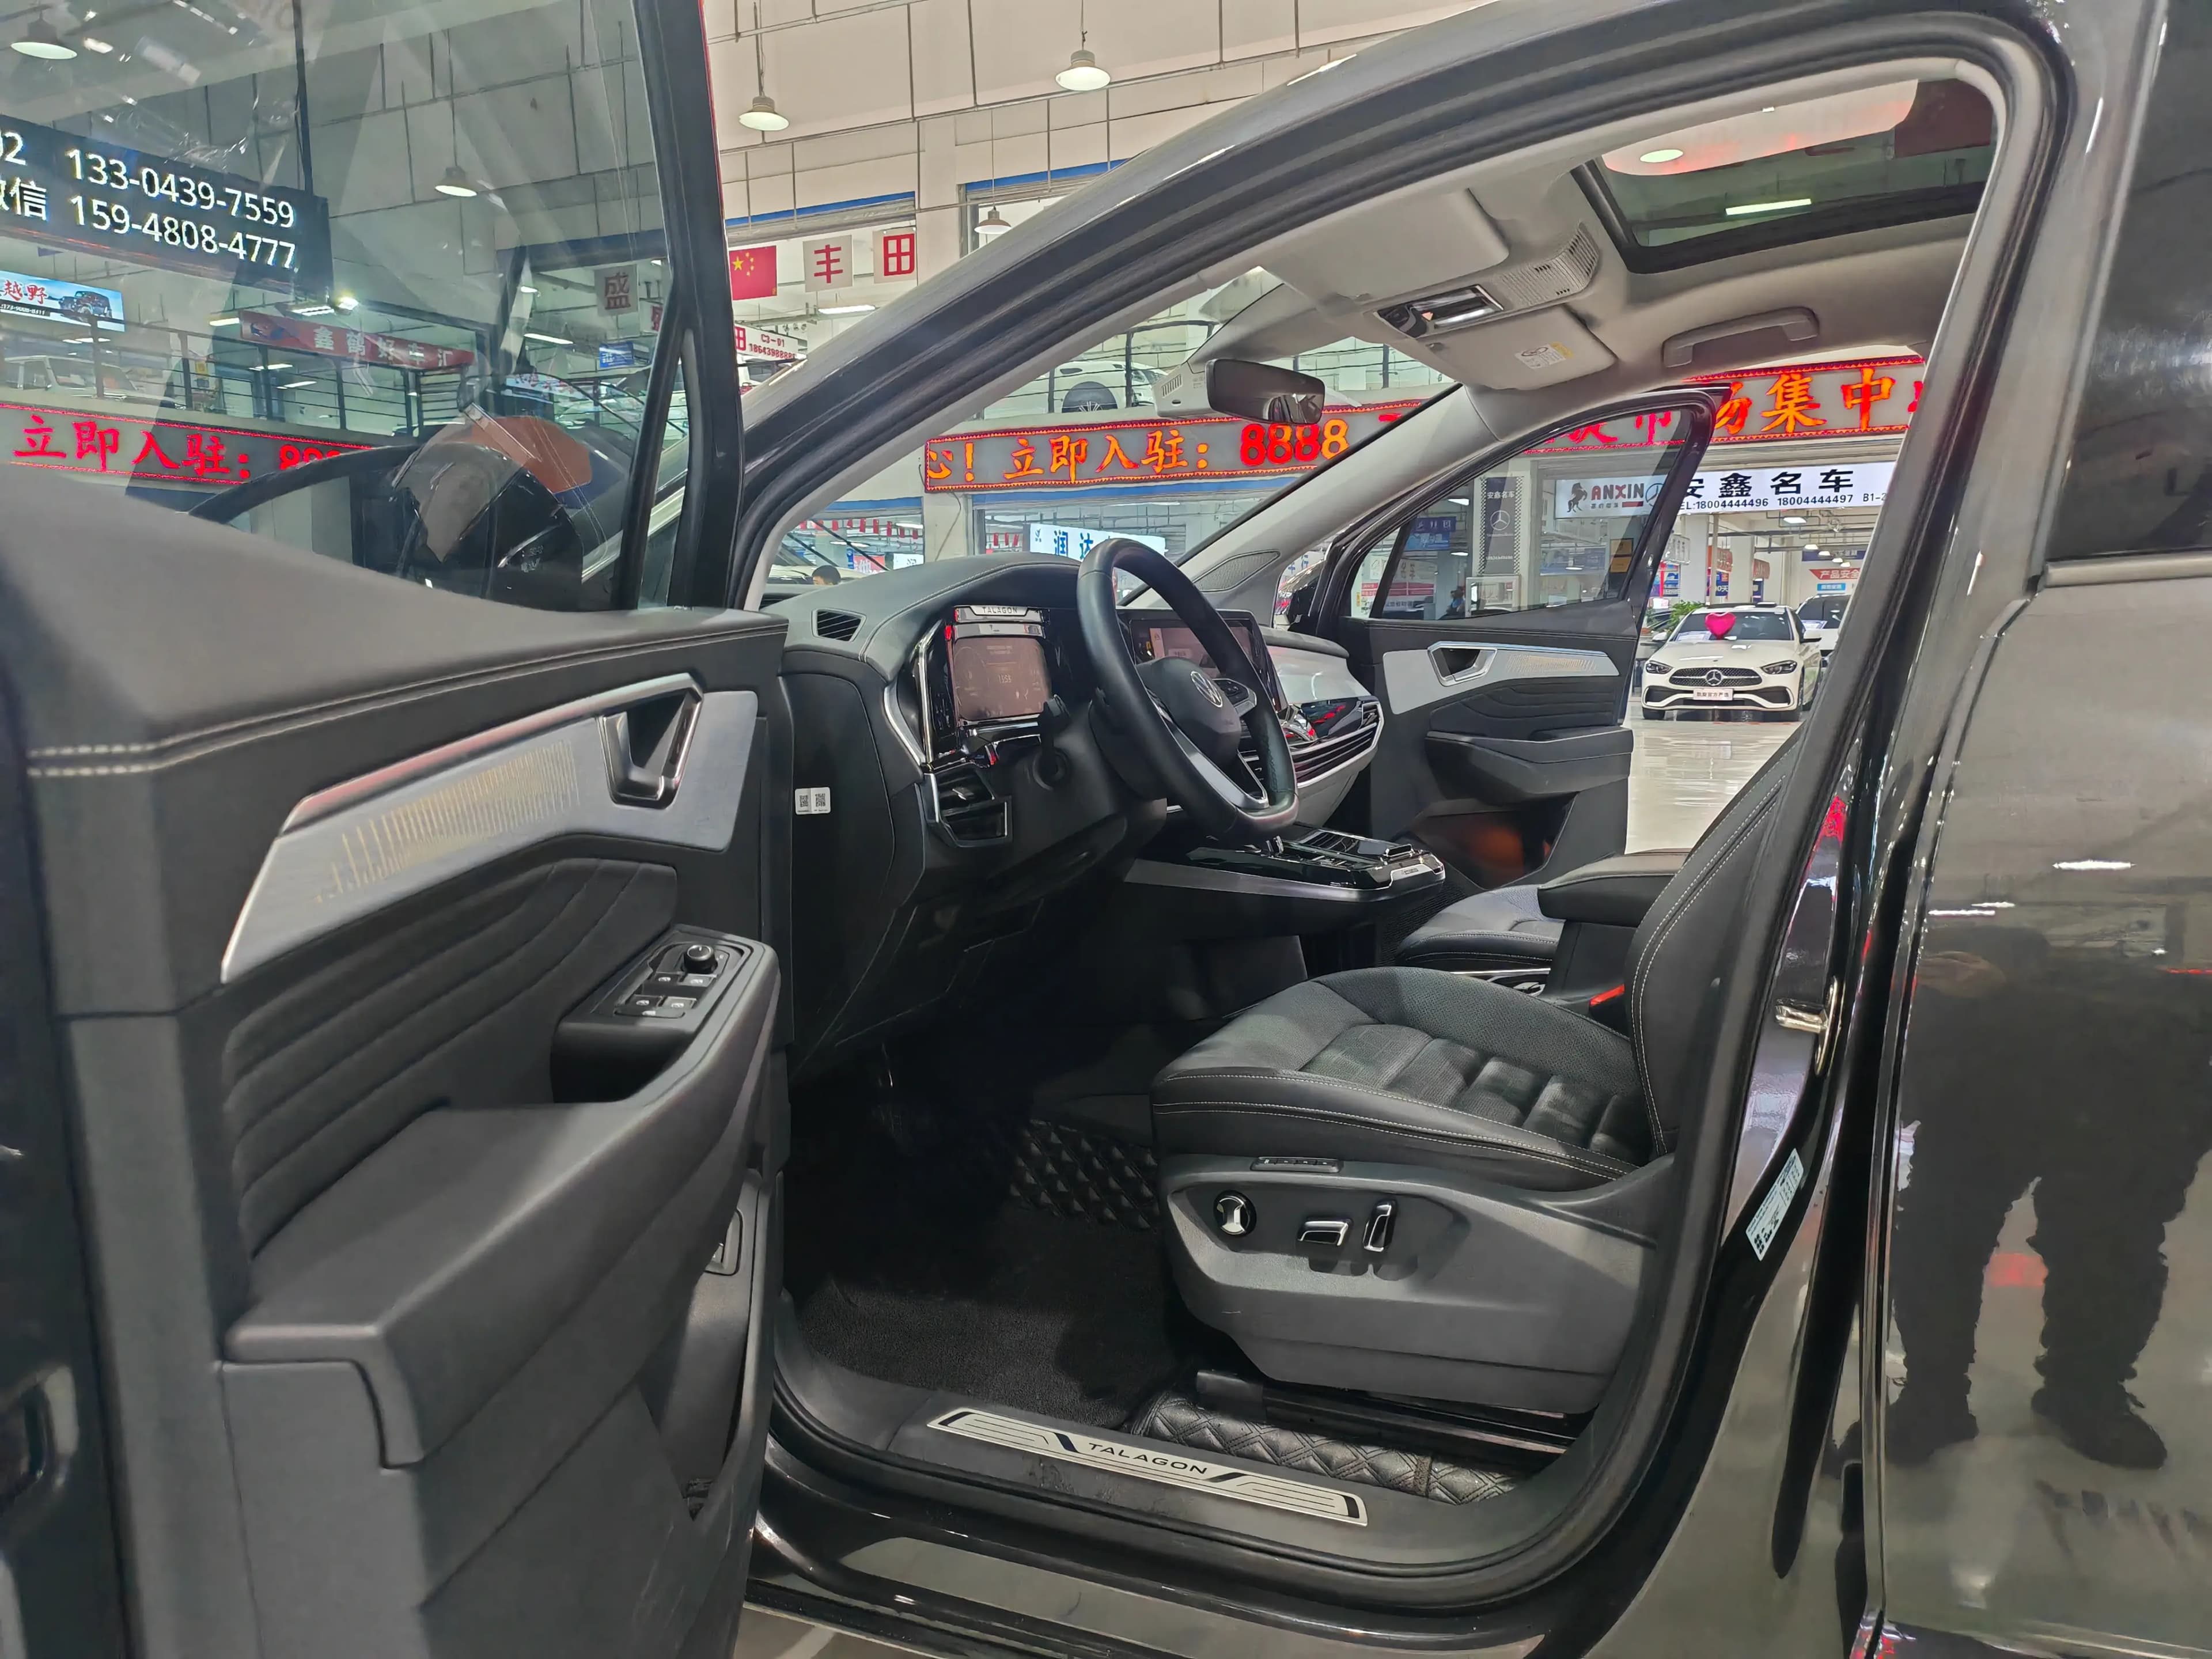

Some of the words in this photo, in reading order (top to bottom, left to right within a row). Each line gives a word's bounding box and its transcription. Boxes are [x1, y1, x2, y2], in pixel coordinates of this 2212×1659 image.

[0, 131, 26, 165] 2
[66, 149, 295, 228] 133-0439-7559
[70, 195, 296, 270] 159-4808-4777
[4, 280, 48, 304] 越野
[1240, 419, 1349, 466] 8888
[1591, 483, 1644, 501] ANXIN
[1777, 494, 1853, 506] 18004444497
[1089, 1442, 1207, 1475] TALAGON
